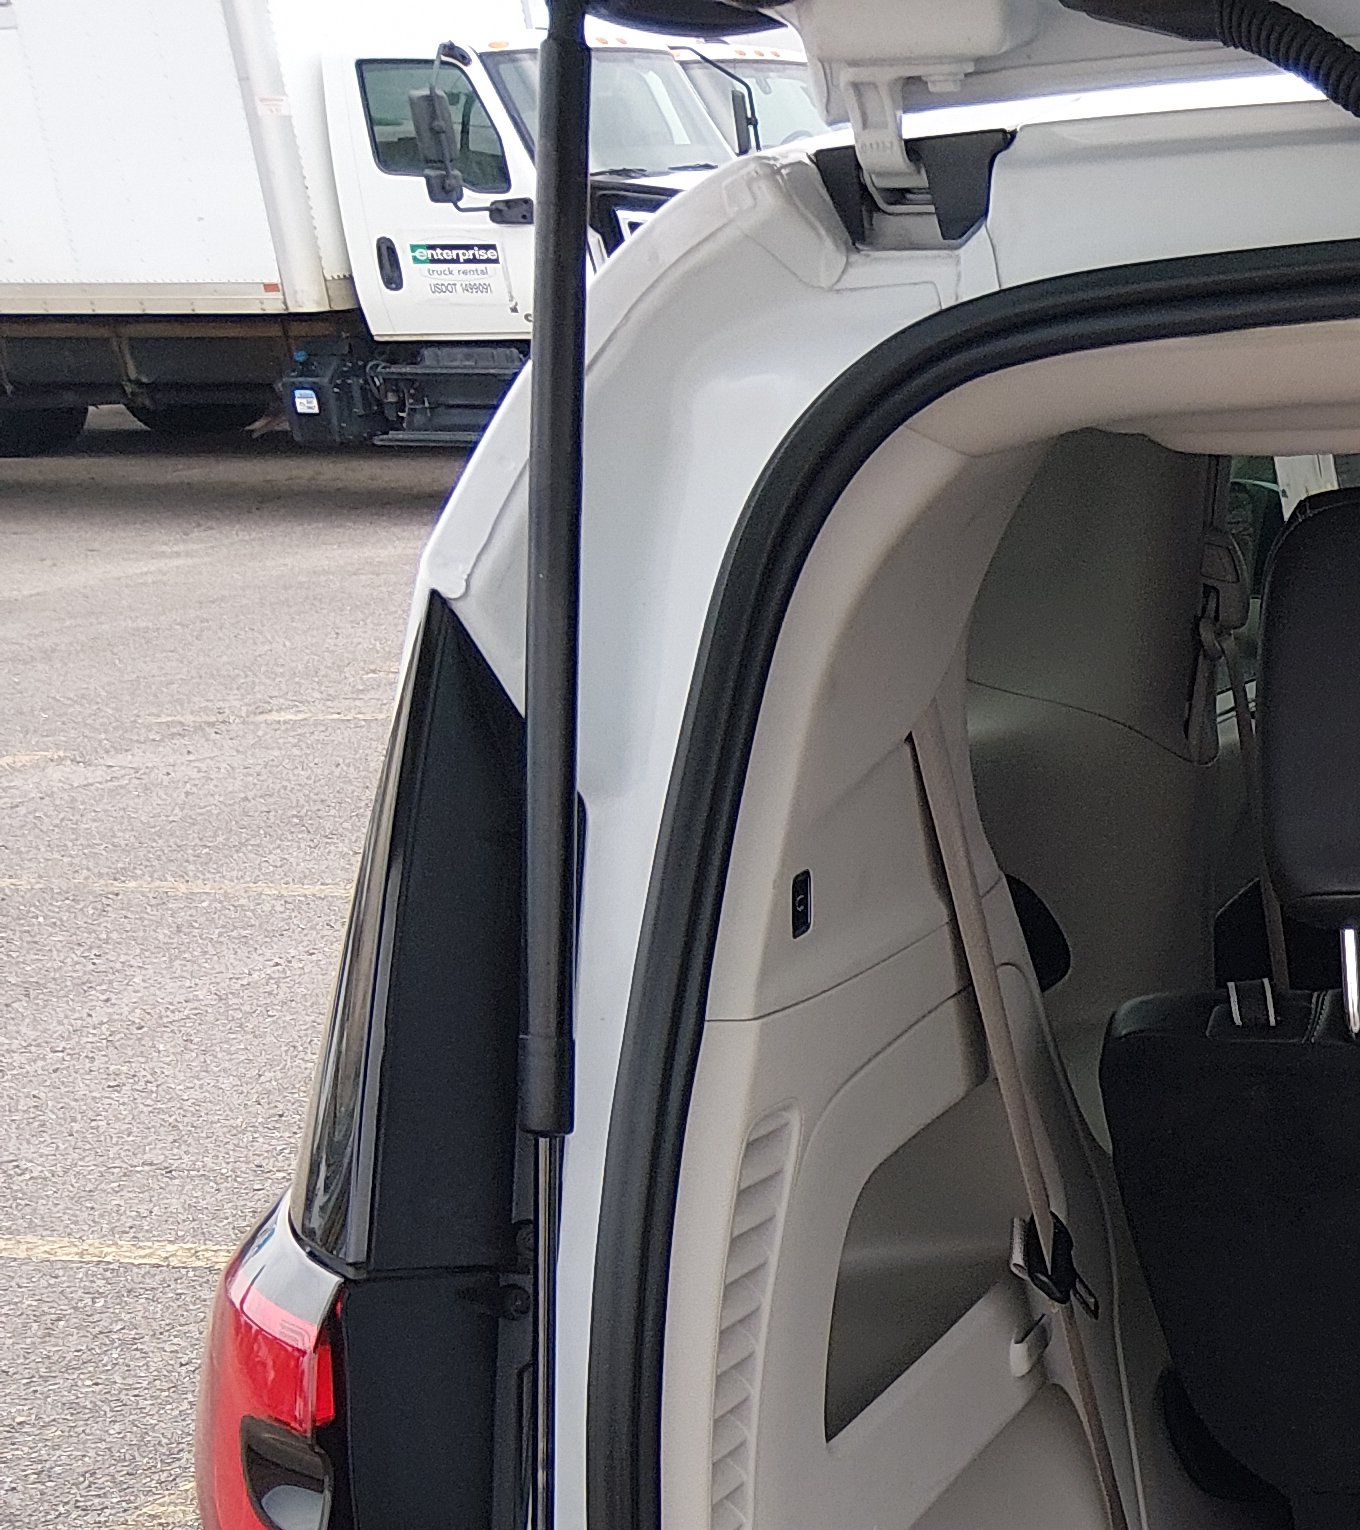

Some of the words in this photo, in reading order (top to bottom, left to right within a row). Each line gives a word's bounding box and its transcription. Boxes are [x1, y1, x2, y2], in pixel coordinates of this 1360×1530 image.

[411, 246, 498, 262] enterprise
[427, 266, 455, 276] truck
[458, 266, 489, 276] rental
[429, 282, 458, 294] USDOT
